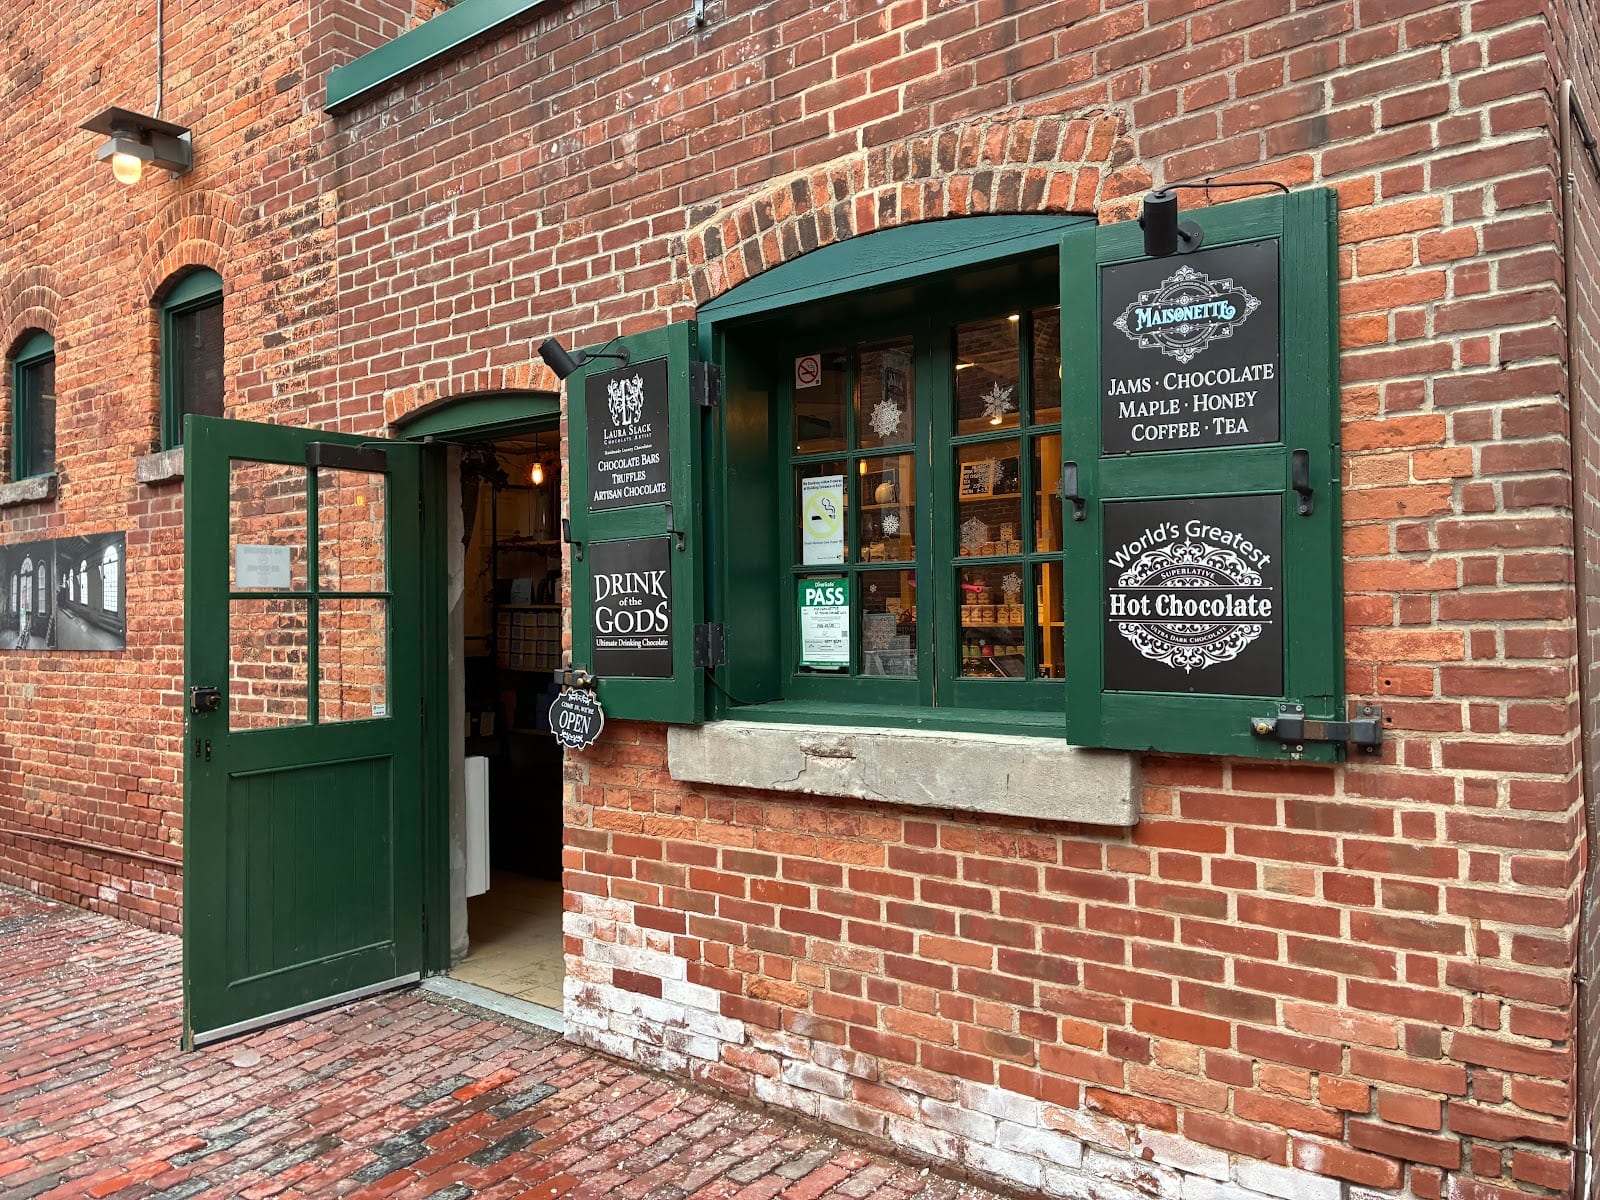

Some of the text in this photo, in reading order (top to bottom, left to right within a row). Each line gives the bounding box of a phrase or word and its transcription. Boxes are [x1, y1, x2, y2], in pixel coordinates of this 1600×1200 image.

[1135, 300, 1236, 332] MAISONETTE
[1108, 363, 1274, 396] JAMS CHOCOLATE
[1119, 391, 1258, 418] MAPLE HONEY
[604, 423, 651, 439] LAURA SLACK
[1131, 417, 1249, 441] COFFEE TEA
[598, 453, 660, 471] CHOCOLATE BARS
[612, 470, 646, 484] TRUFFLES
[594, 482, 666, 501] ARTISAN CHOCOLATE
[1109, 520, 1271, 569] World's Greatest
[1161, 568, 1216, 579] SUPERLATIVE
[593, 570, 668, 602] DRINK
[806, 587, 844, 605] PASS
[619, 597, 642, 606] of the
[1109, 594, 1272, 617] Hot Chocolate
[595, 601, 668, 633] GODS
[596, 637, 668, 648] Ultimate Drinking Chocolate
[1150, 625, 1227, 643] ULTRA DARK CHOCOLATE
[559, 710, 591, 734] OPEN
